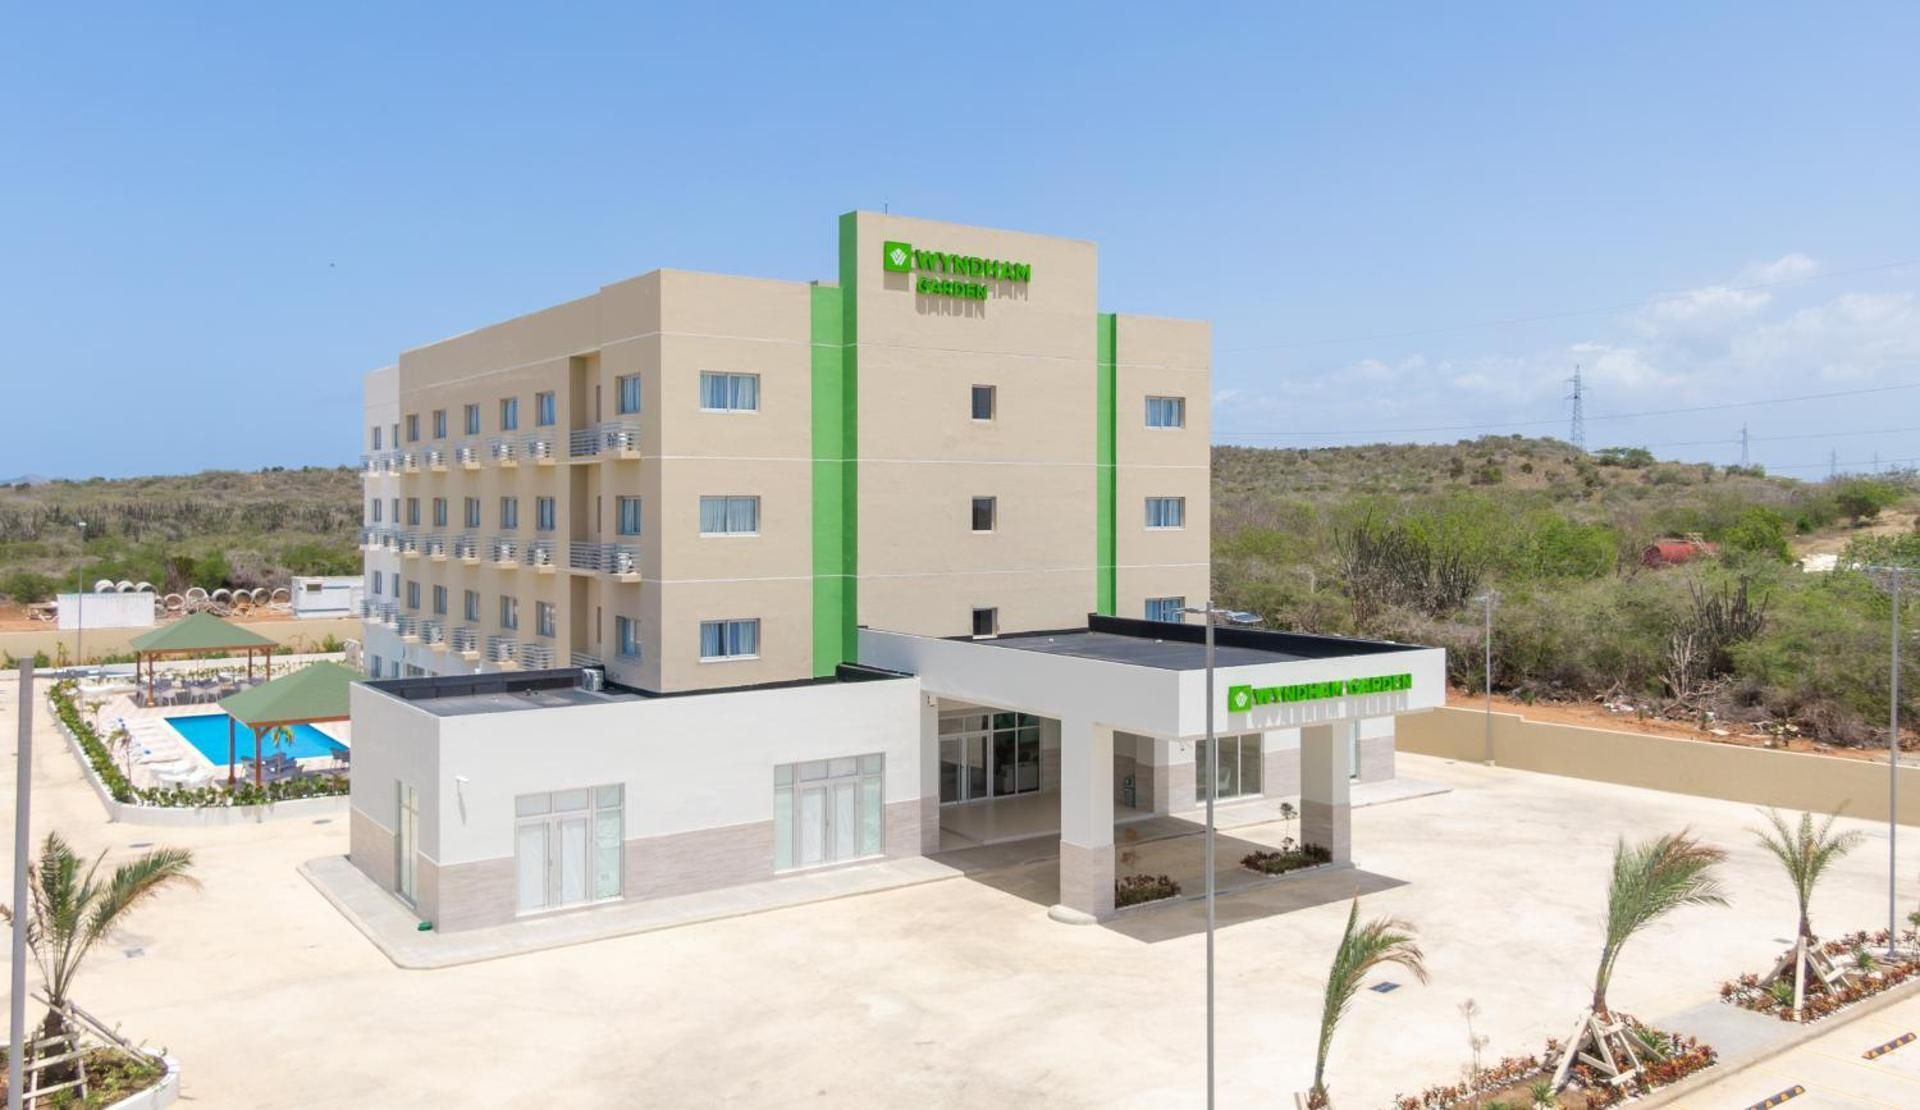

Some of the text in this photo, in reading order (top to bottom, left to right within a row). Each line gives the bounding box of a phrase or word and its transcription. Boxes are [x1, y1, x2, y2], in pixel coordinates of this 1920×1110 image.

[915, 250, 1030, 282] WYNDHAM
[916, 278, 986, 300] GARDEN
[1252, 674, 1411, 705] WYNDHAM GARDEN
